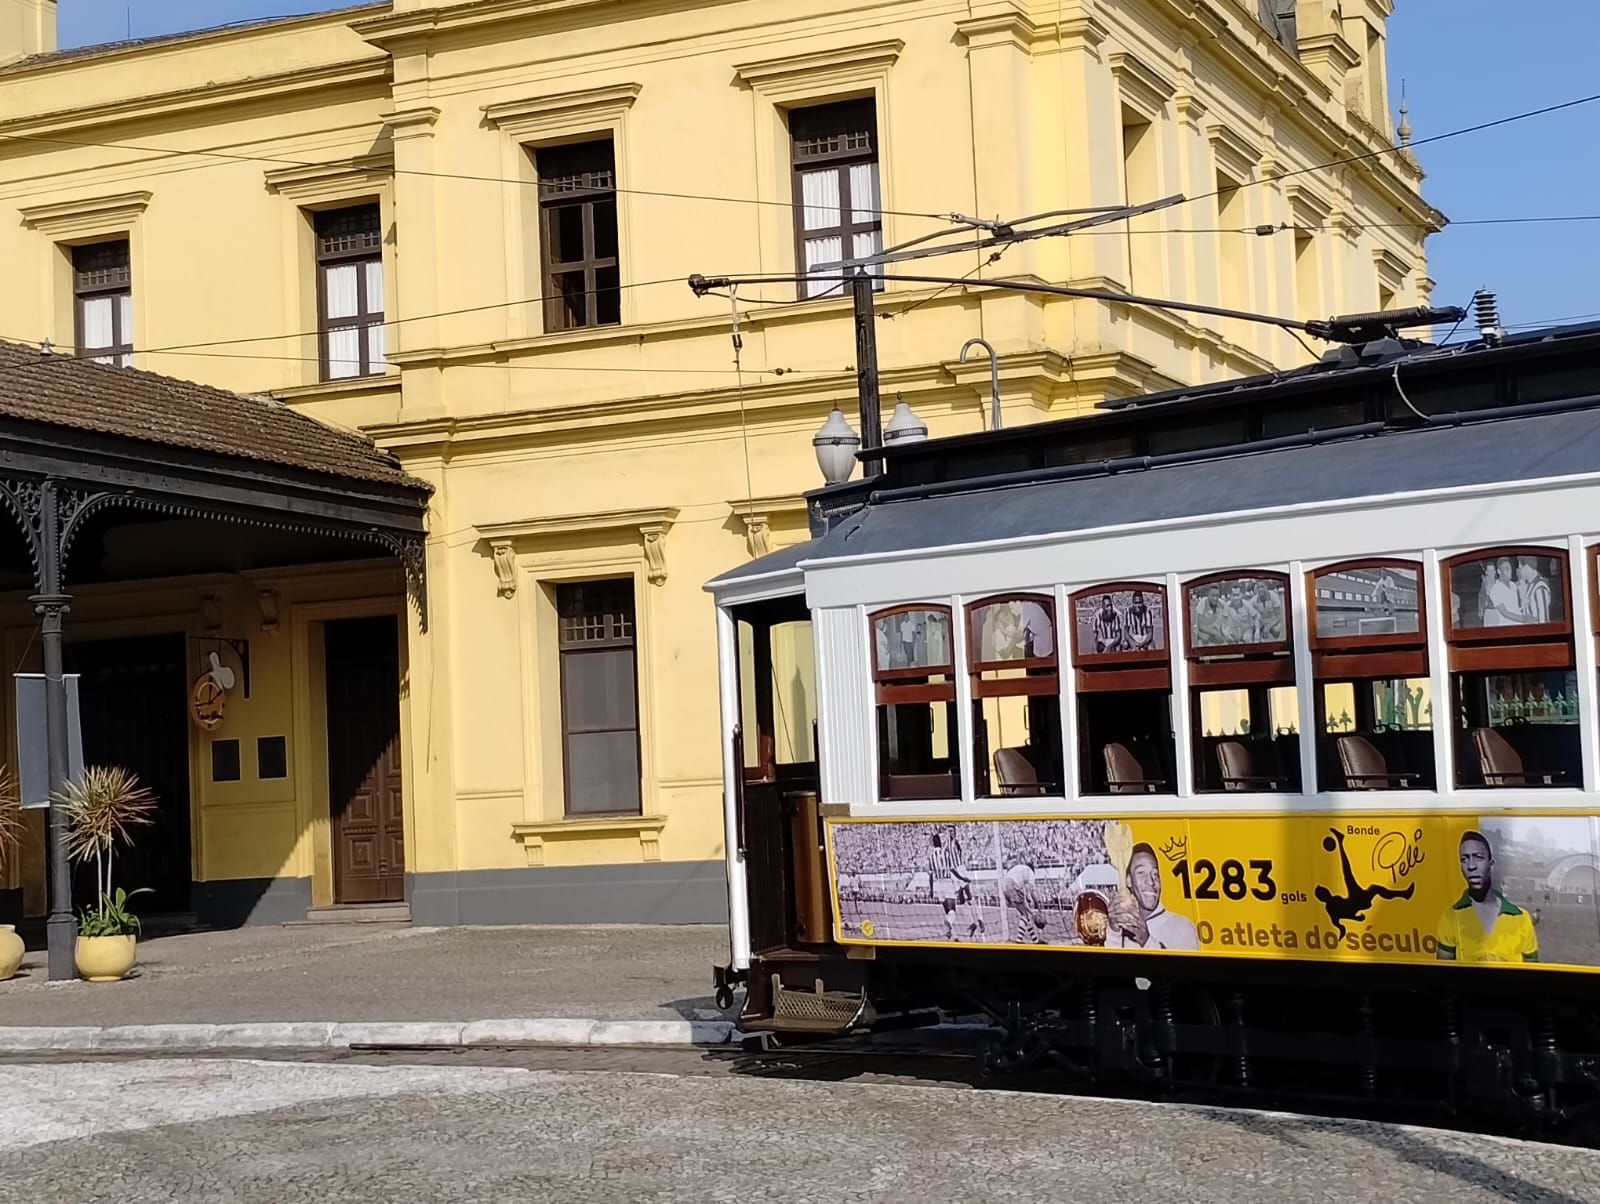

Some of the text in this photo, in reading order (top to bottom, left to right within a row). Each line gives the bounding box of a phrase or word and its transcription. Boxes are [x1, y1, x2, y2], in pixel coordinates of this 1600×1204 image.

[1347, 825, 1381, 836] Bonde
[1172, 859, 1308, 905] 1283 gols
[1196, 920, 1438, 954] O atleta do século
